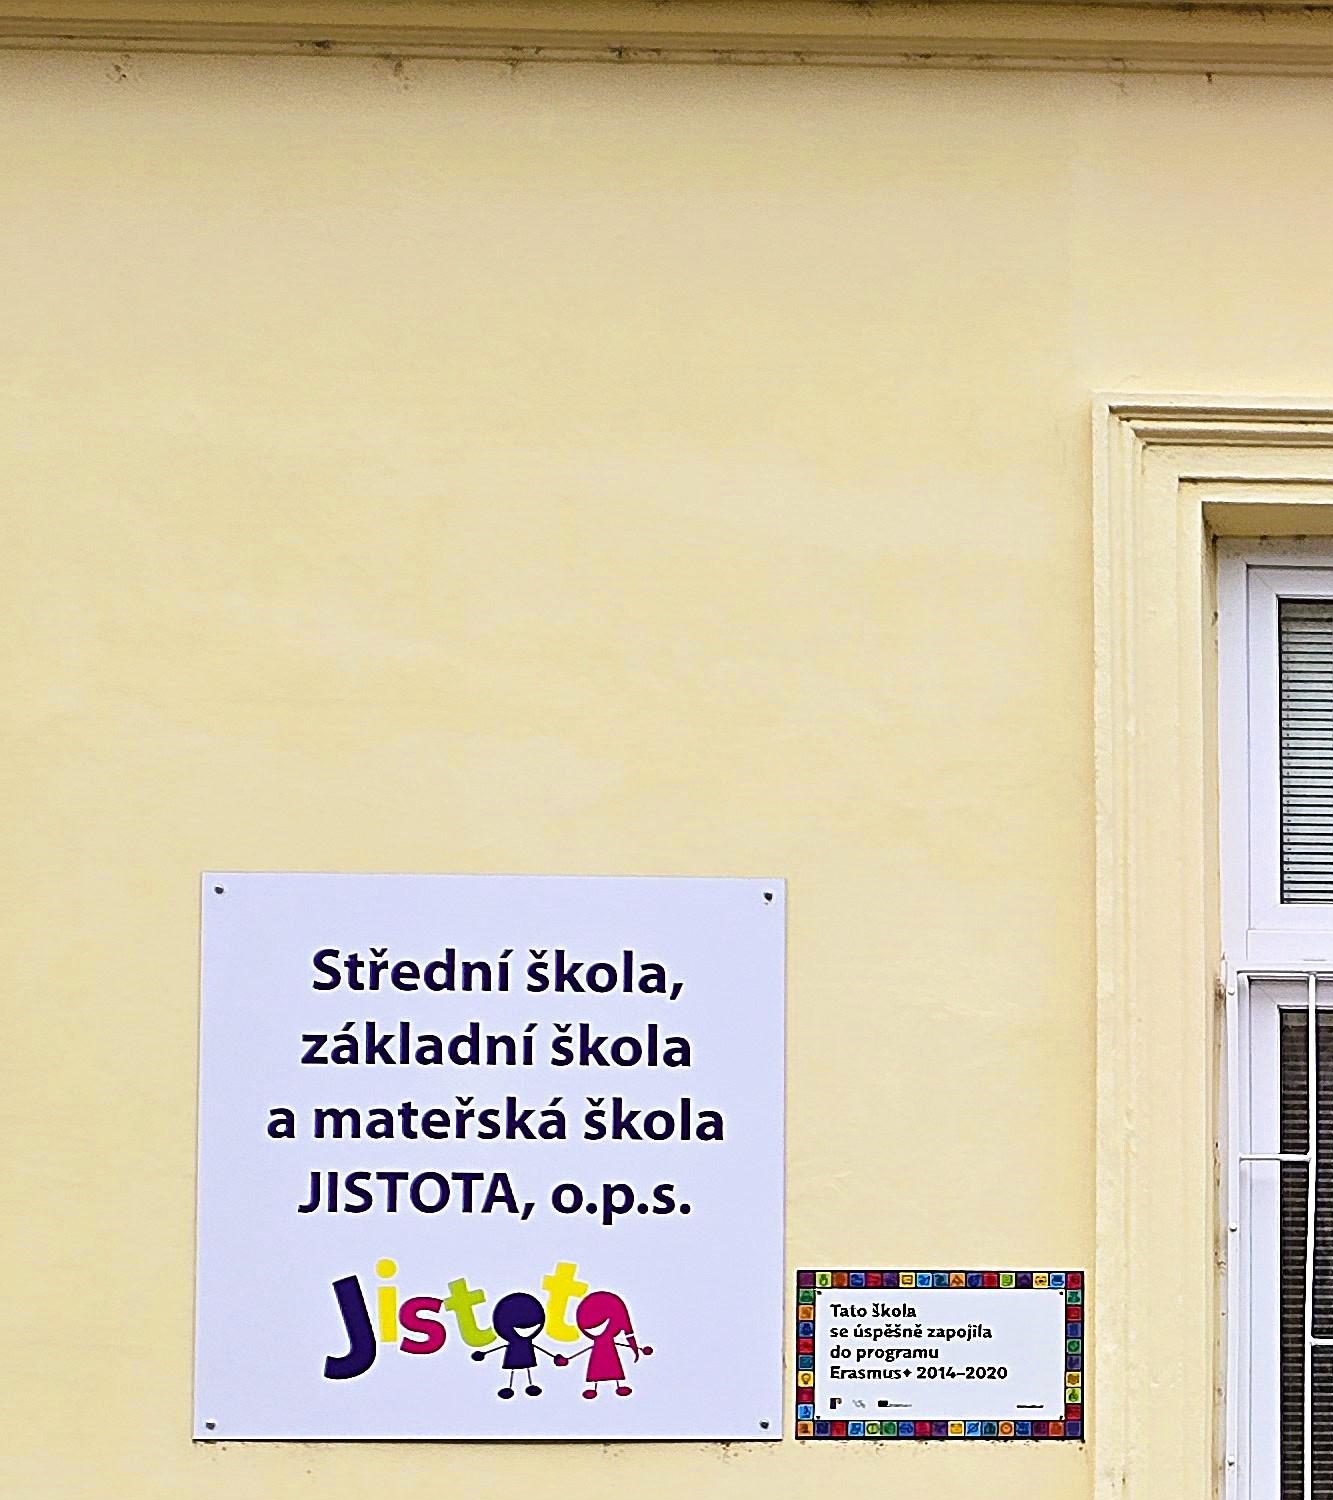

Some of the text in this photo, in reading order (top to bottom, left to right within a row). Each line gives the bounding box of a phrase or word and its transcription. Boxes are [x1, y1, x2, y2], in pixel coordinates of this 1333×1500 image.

[312, 947, 684, 1001] Střední škola,
[300, 1020, 691, 1068] základní škola
[267, 1095, 724, 1142] a mateřská škola
[297, 1171, 691, 1226] JISTOTA, o.p.s.
[829, 1302, 917, 1318] Tato škola
[829, 1323, 993, 1342] se úspěšně zapojila
[829, 1344, 939, 1362] do programu
